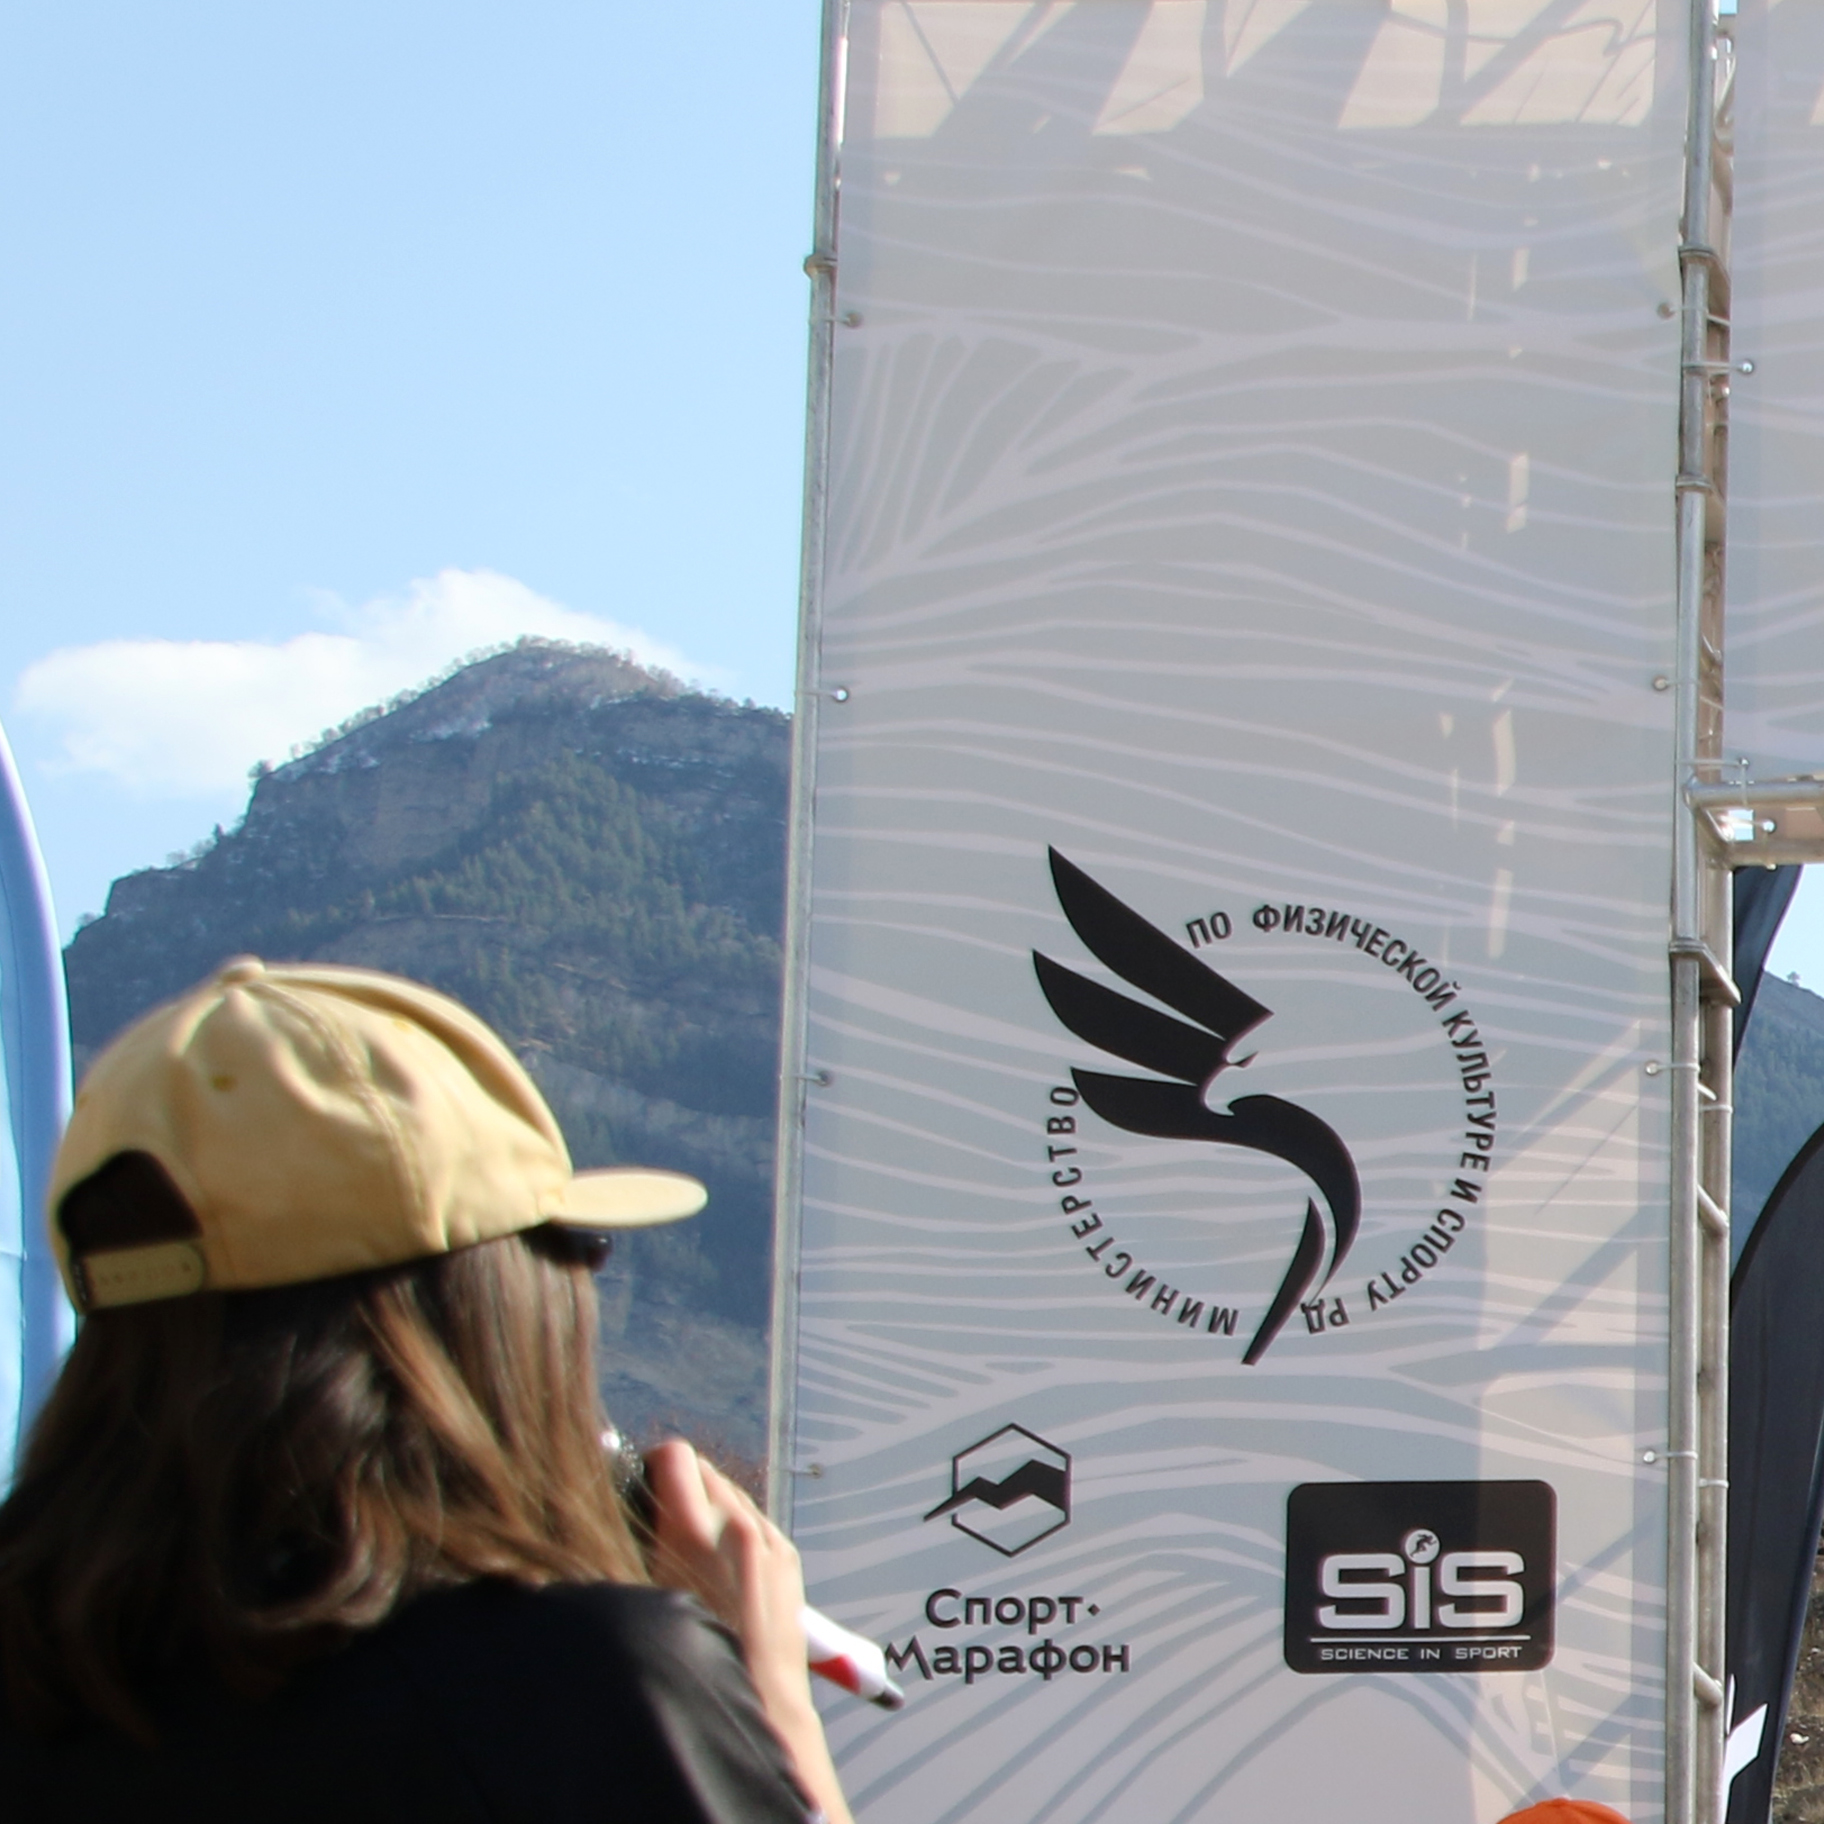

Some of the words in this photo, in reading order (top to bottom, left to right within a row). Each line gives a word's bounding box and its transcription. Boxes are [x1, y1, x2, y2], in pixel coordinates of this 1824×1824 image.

[1183, 908, 1234, 950] ПО
[1250, 901, 1460, 1014] ФИЗИЧЕСКОЙ
[1442, 1006, 1498, 1174] КУЛЬТУРЕ
[1045, 1084, 1241, 1340] МИНИСТЕРСТВО
[1457, 1177, 1482, 1203] И
[1367, 1207, 1468, 1314] СПОРТУ
[1300, 1297, 1349, 1338] РД
[884, 1634, 1132, 1685] Марафон
[1319, 1645, 1411, 1663] SCIENCE
[1419, 1645, 1443, 1662] IN
[1454, 1644, 1524, 1661] SPORT
